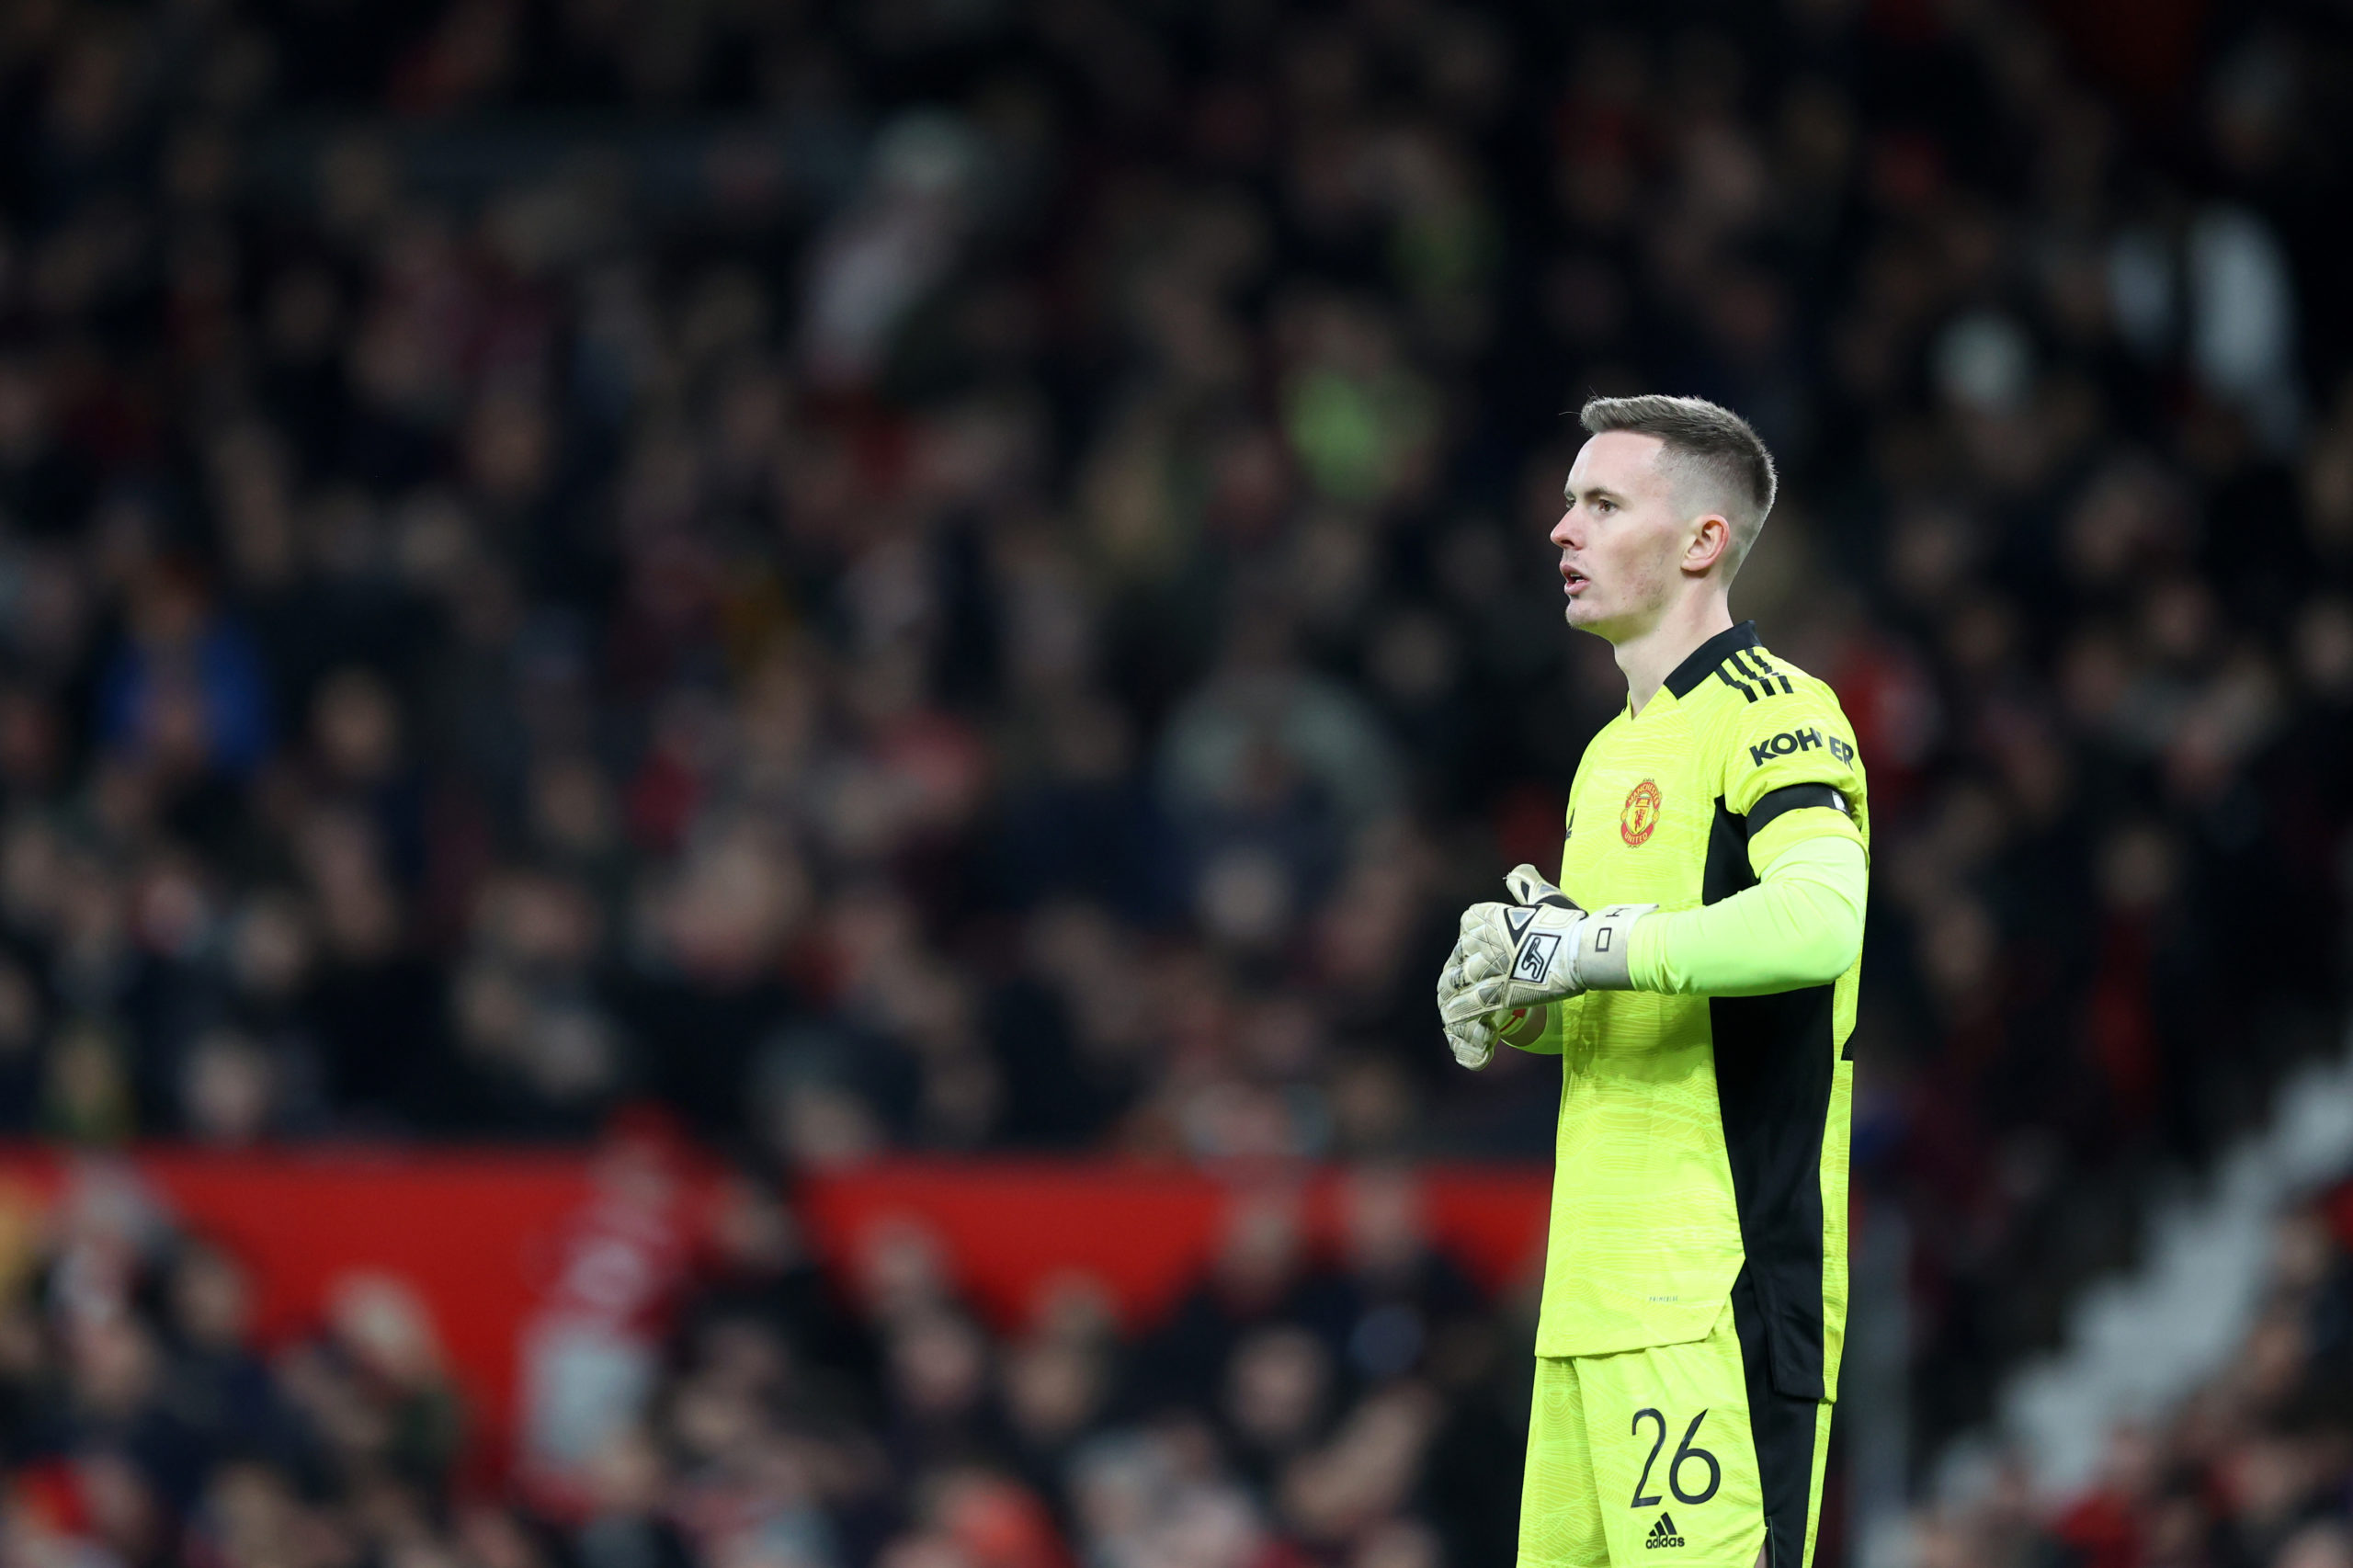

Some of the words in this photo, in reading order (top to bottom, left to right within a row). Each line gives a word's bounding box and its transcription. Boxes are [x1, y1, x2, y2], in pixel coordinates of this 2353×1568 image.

[1749, 727, 1855, 771] KOHER
[1624, 831, 1648, 844] UNITED
[1631, 1407, 1721, 1508] 26
[1645, 1535, 1685, 1550] adidas
